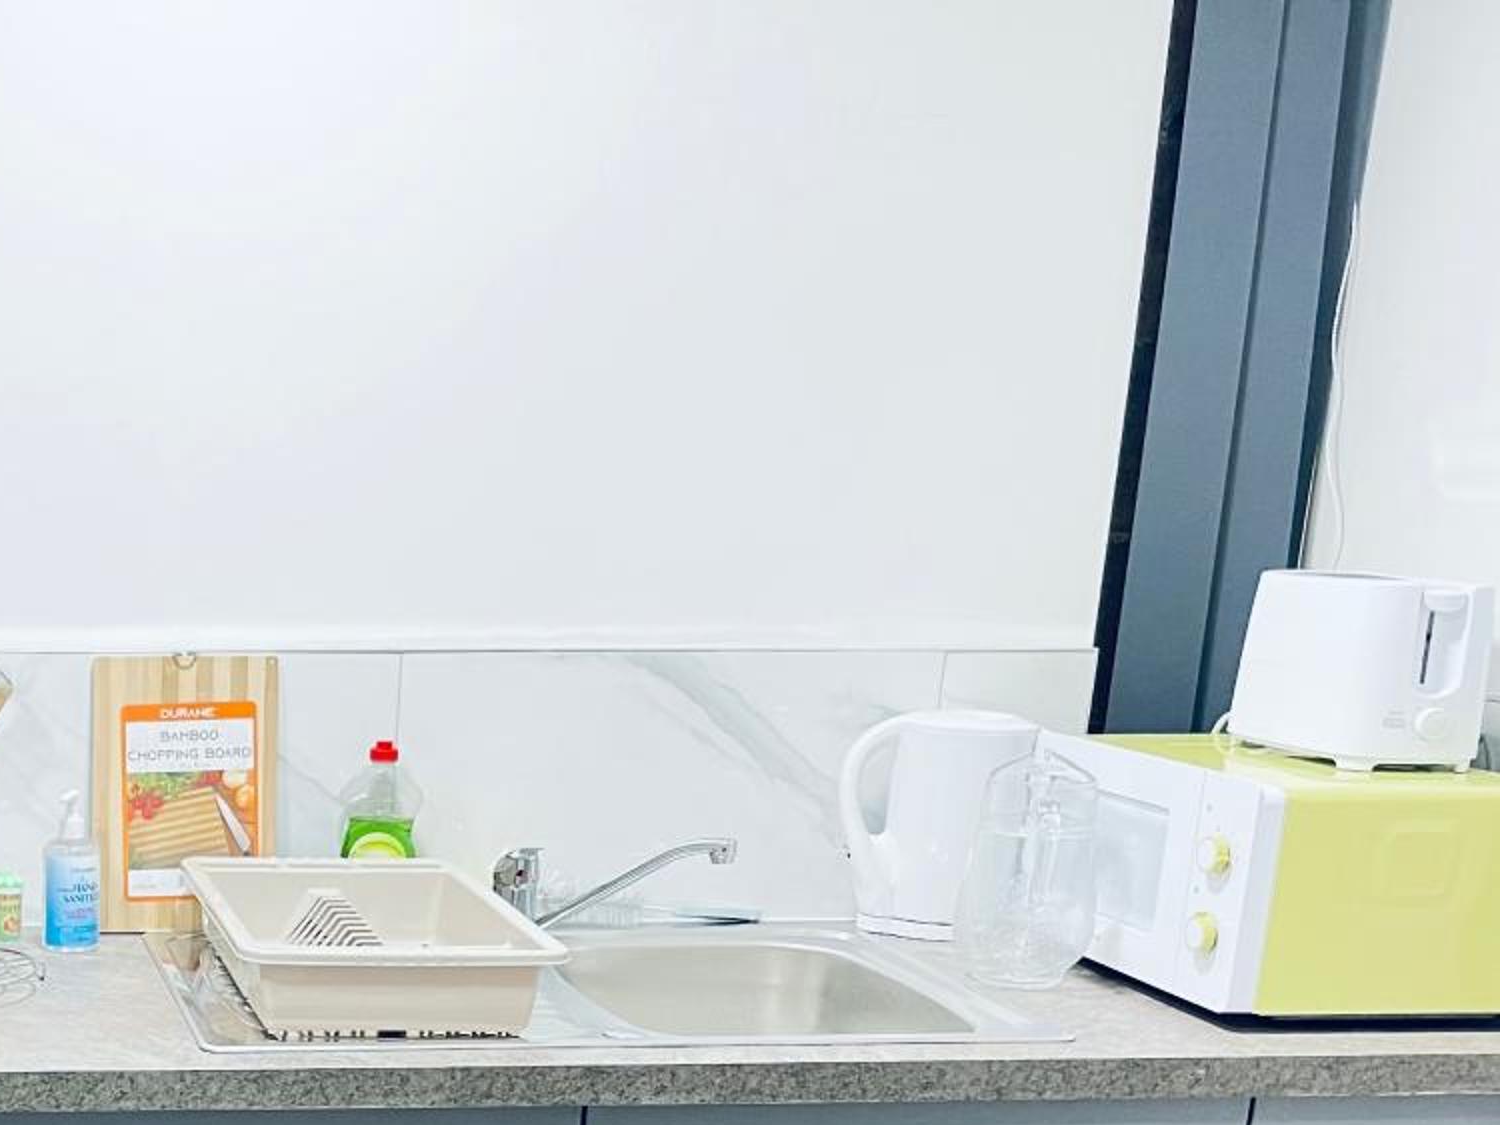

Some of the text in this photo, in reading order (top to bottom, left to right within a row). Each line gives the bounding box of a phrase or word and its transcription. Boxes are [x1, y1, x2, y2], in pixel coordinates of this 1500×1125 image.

[160, 729, 219, 742] BAMBOO
[128, 747, 251, 761] CHOPPING BOARD
